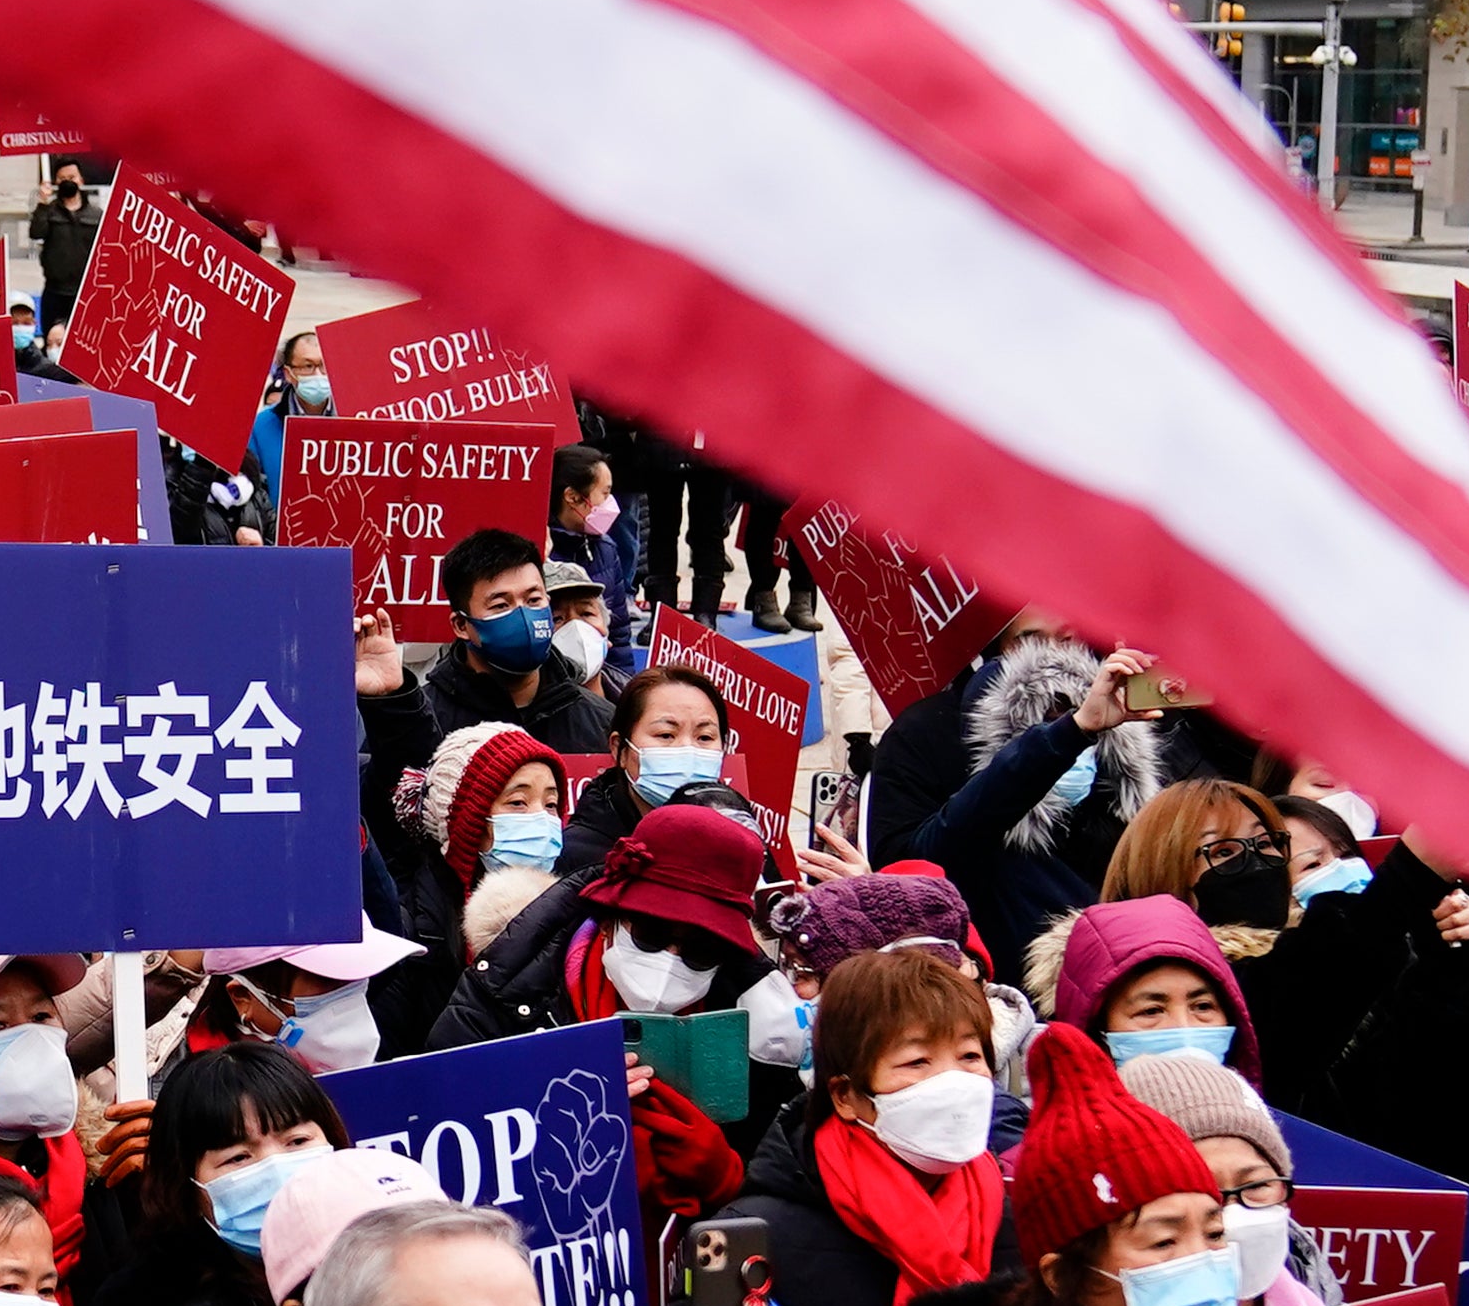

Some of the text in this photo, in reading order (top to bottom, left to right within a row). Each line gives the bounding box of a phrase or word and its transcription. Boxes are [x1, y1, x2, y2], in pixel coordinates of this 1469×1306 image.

[117, 188, 283, 323] PUBLIC SAFETY
[162, 283, 207, 340] FOR
[132, 340, 198, 407] ALL
[389, 327, 497, 386] STOP!!
[466, 364, 551, 412] BULLY
[299, 437, 541, 482] PUBLIC SAFETY
[385, 502, 446, 540] FOR
[909, 553, 981, 644] ALL
[656, 633, 801, 737] BROTHERLY LOVE
[357, 1106, 539, 1212] OP
